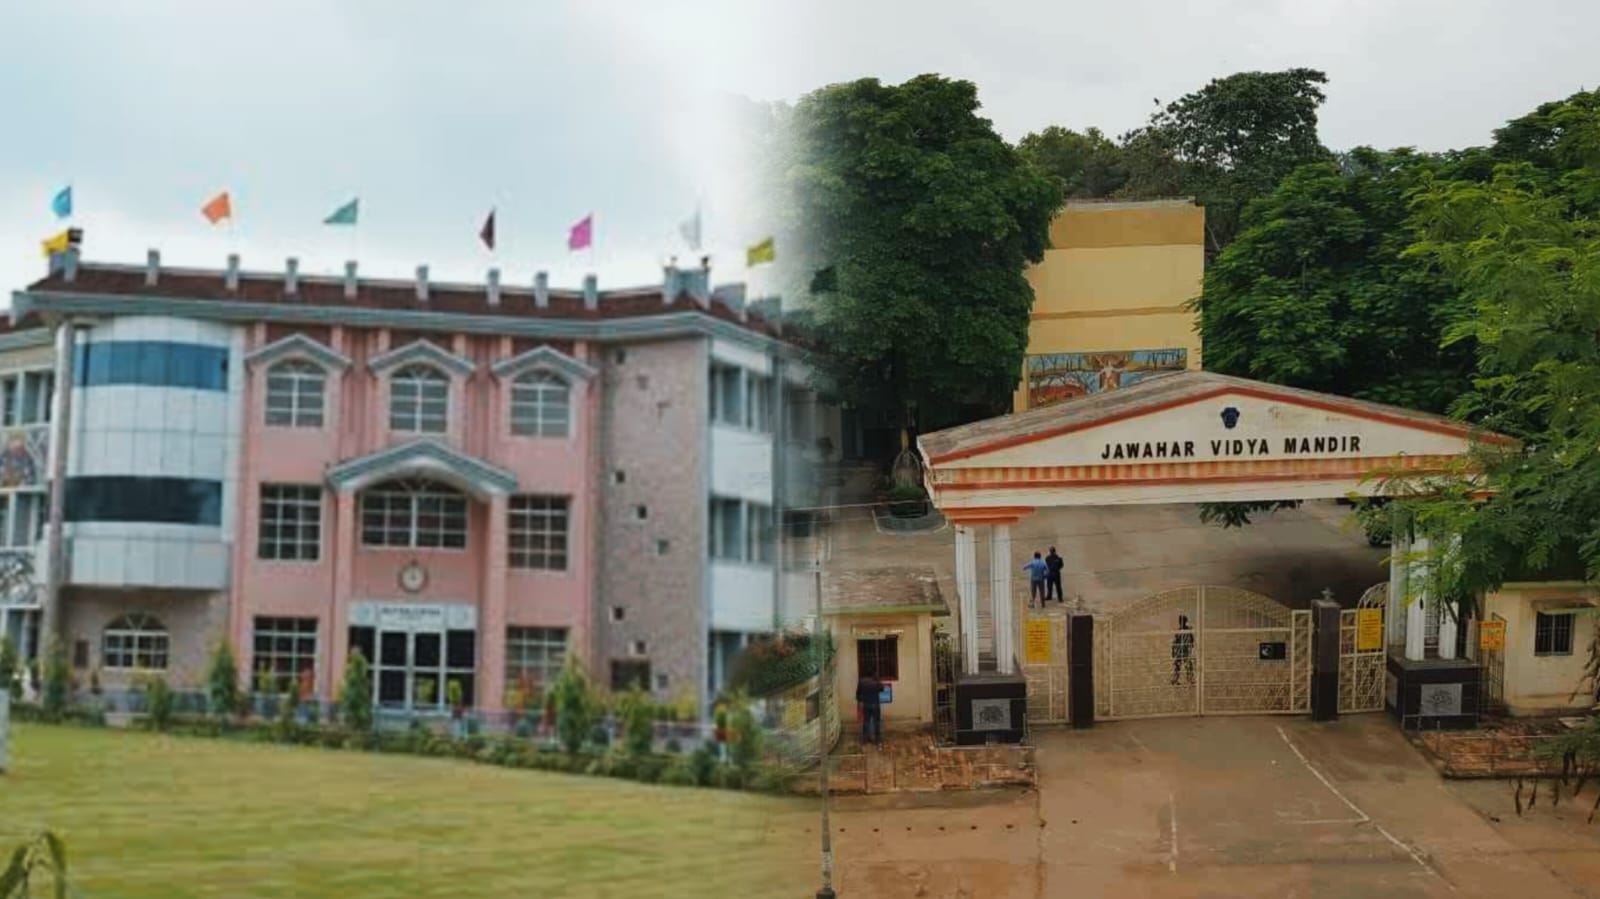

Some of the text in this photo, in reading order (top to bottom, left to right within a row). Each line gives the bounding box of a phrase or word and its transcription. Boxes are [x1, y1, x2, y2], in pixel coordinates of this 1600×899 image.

[1101, 435, 1361, 460] JAWAHAR VIDYA MANDIR
